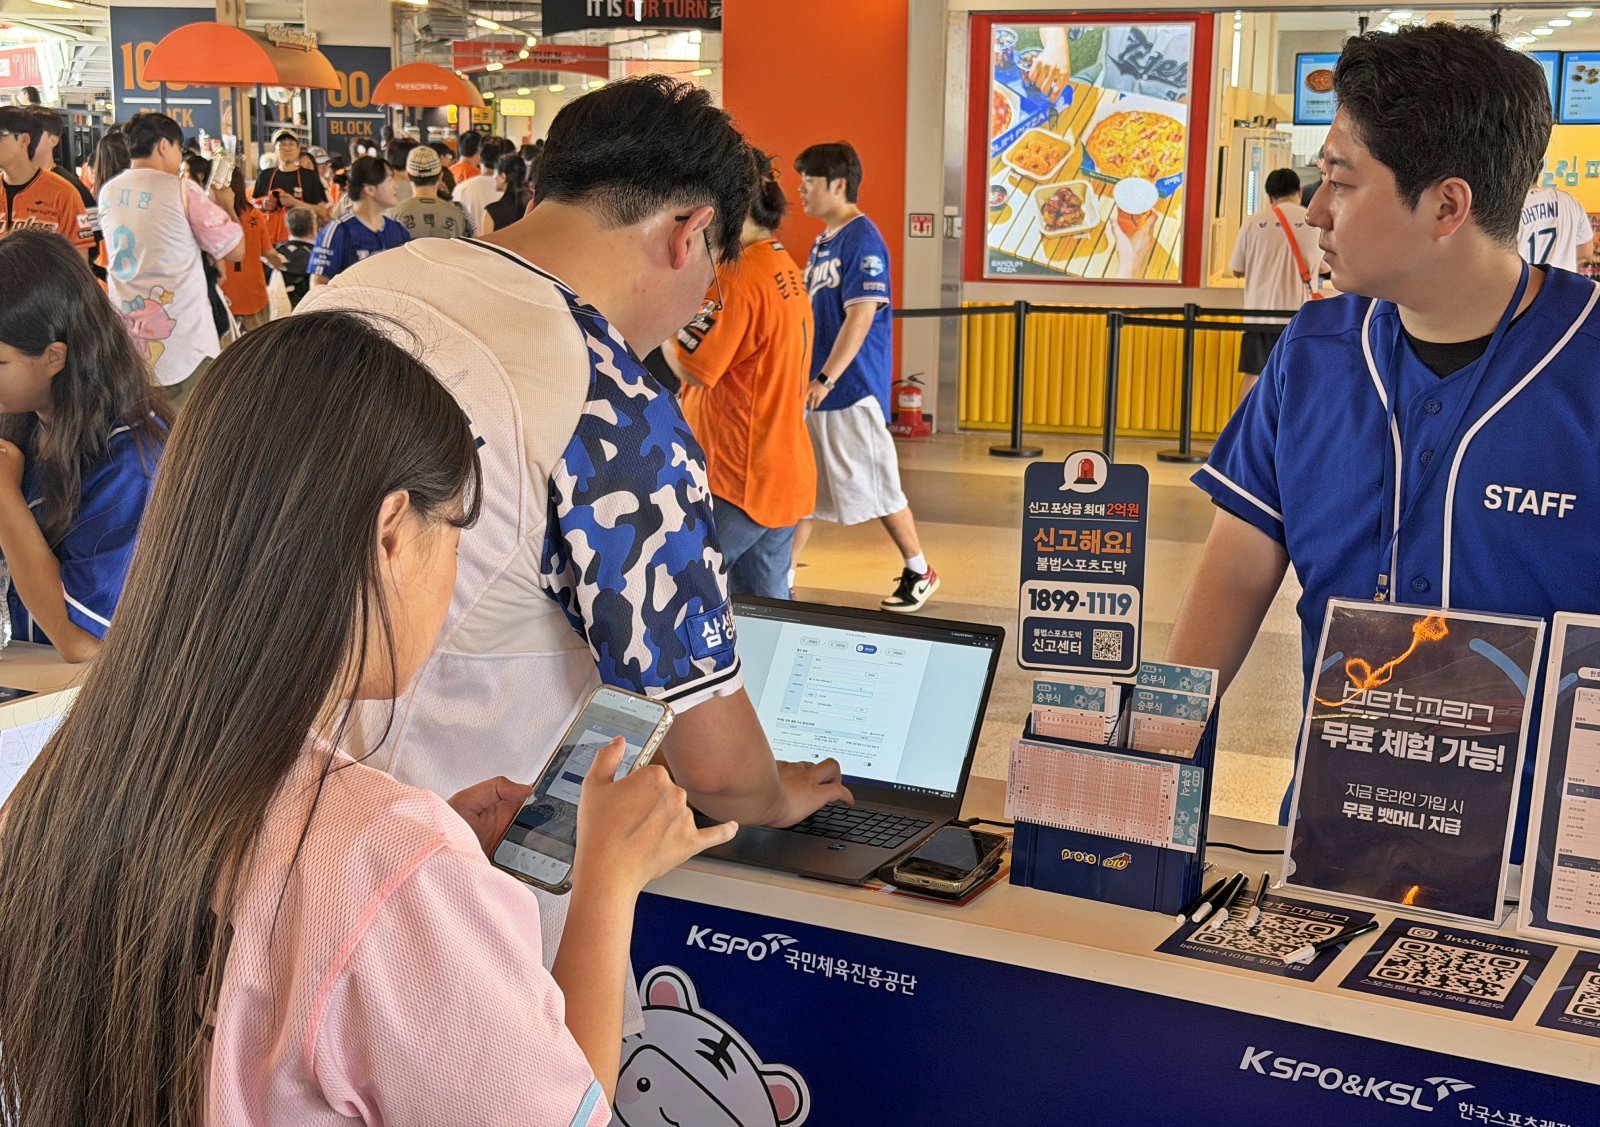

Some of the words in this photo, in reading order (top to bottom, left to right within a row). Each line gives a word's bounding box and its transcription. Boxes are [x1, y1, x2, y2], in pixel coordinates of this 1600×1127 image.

[586, 0, 601, 17] IT
[607, 0, 622, 17] IS
[664, 0, 707, 18] TURN
[330, 121, 373, 135] BLOCK
[113, 224, 139, 281] 8
[1527, 227, 1557, 265] 17
[1028, 501, 1049, 514] 신고
[1050, 502, 1083, 516] 포상금
[1083, 503, 1105, 517] 최대
[1106, 503, 1140, 517] 2억원
[1484, 484, 1577, 518] STAFF
[1033, 527, 1132, 555] 신고해요!
[1036, 556, 1127, 576] 불법스포츠도박
[1028, 588, 1132, 616] 1899-1119
[1032, 638, 1082, 656] 신고센터
[1033, 628, 1083, 639] 불법스포츠도박
[1141, 673, 1166, 686] 승부식
[1036, 692, 1061, 704] 승부식
[1137, 701, 1163, 713] 승부식
[1341, 681, 1494, 724] betman
[1321, 720, 1375, 754] 무료
[1379, 728, 1436, 763] 체험
[1439, 737, 1506, 773] 가능!
[1179, 769, 1192, 796] 승부식
[1345, 782, 1374, 800] 지금
[1375, 787, 1416, 807] 온라인
[1418, 794, 1447, 812] 가입
[1449, 800, 1464, 815] 시
[1342, 801, 1374, 821] 무료
[1428, 815, 1462, 836] 지급
[1061, 848, 1096, 865] proto
[686, 925, 767, 962] KSPO
[1443, 932, 1531, 956] Instagram
[783, 948, 918, 996] 국민체육진흥공단
[1444, 994, 1466, 1003] SNS
[1239, 1046, 1434, 1112] KSPO&KSL
